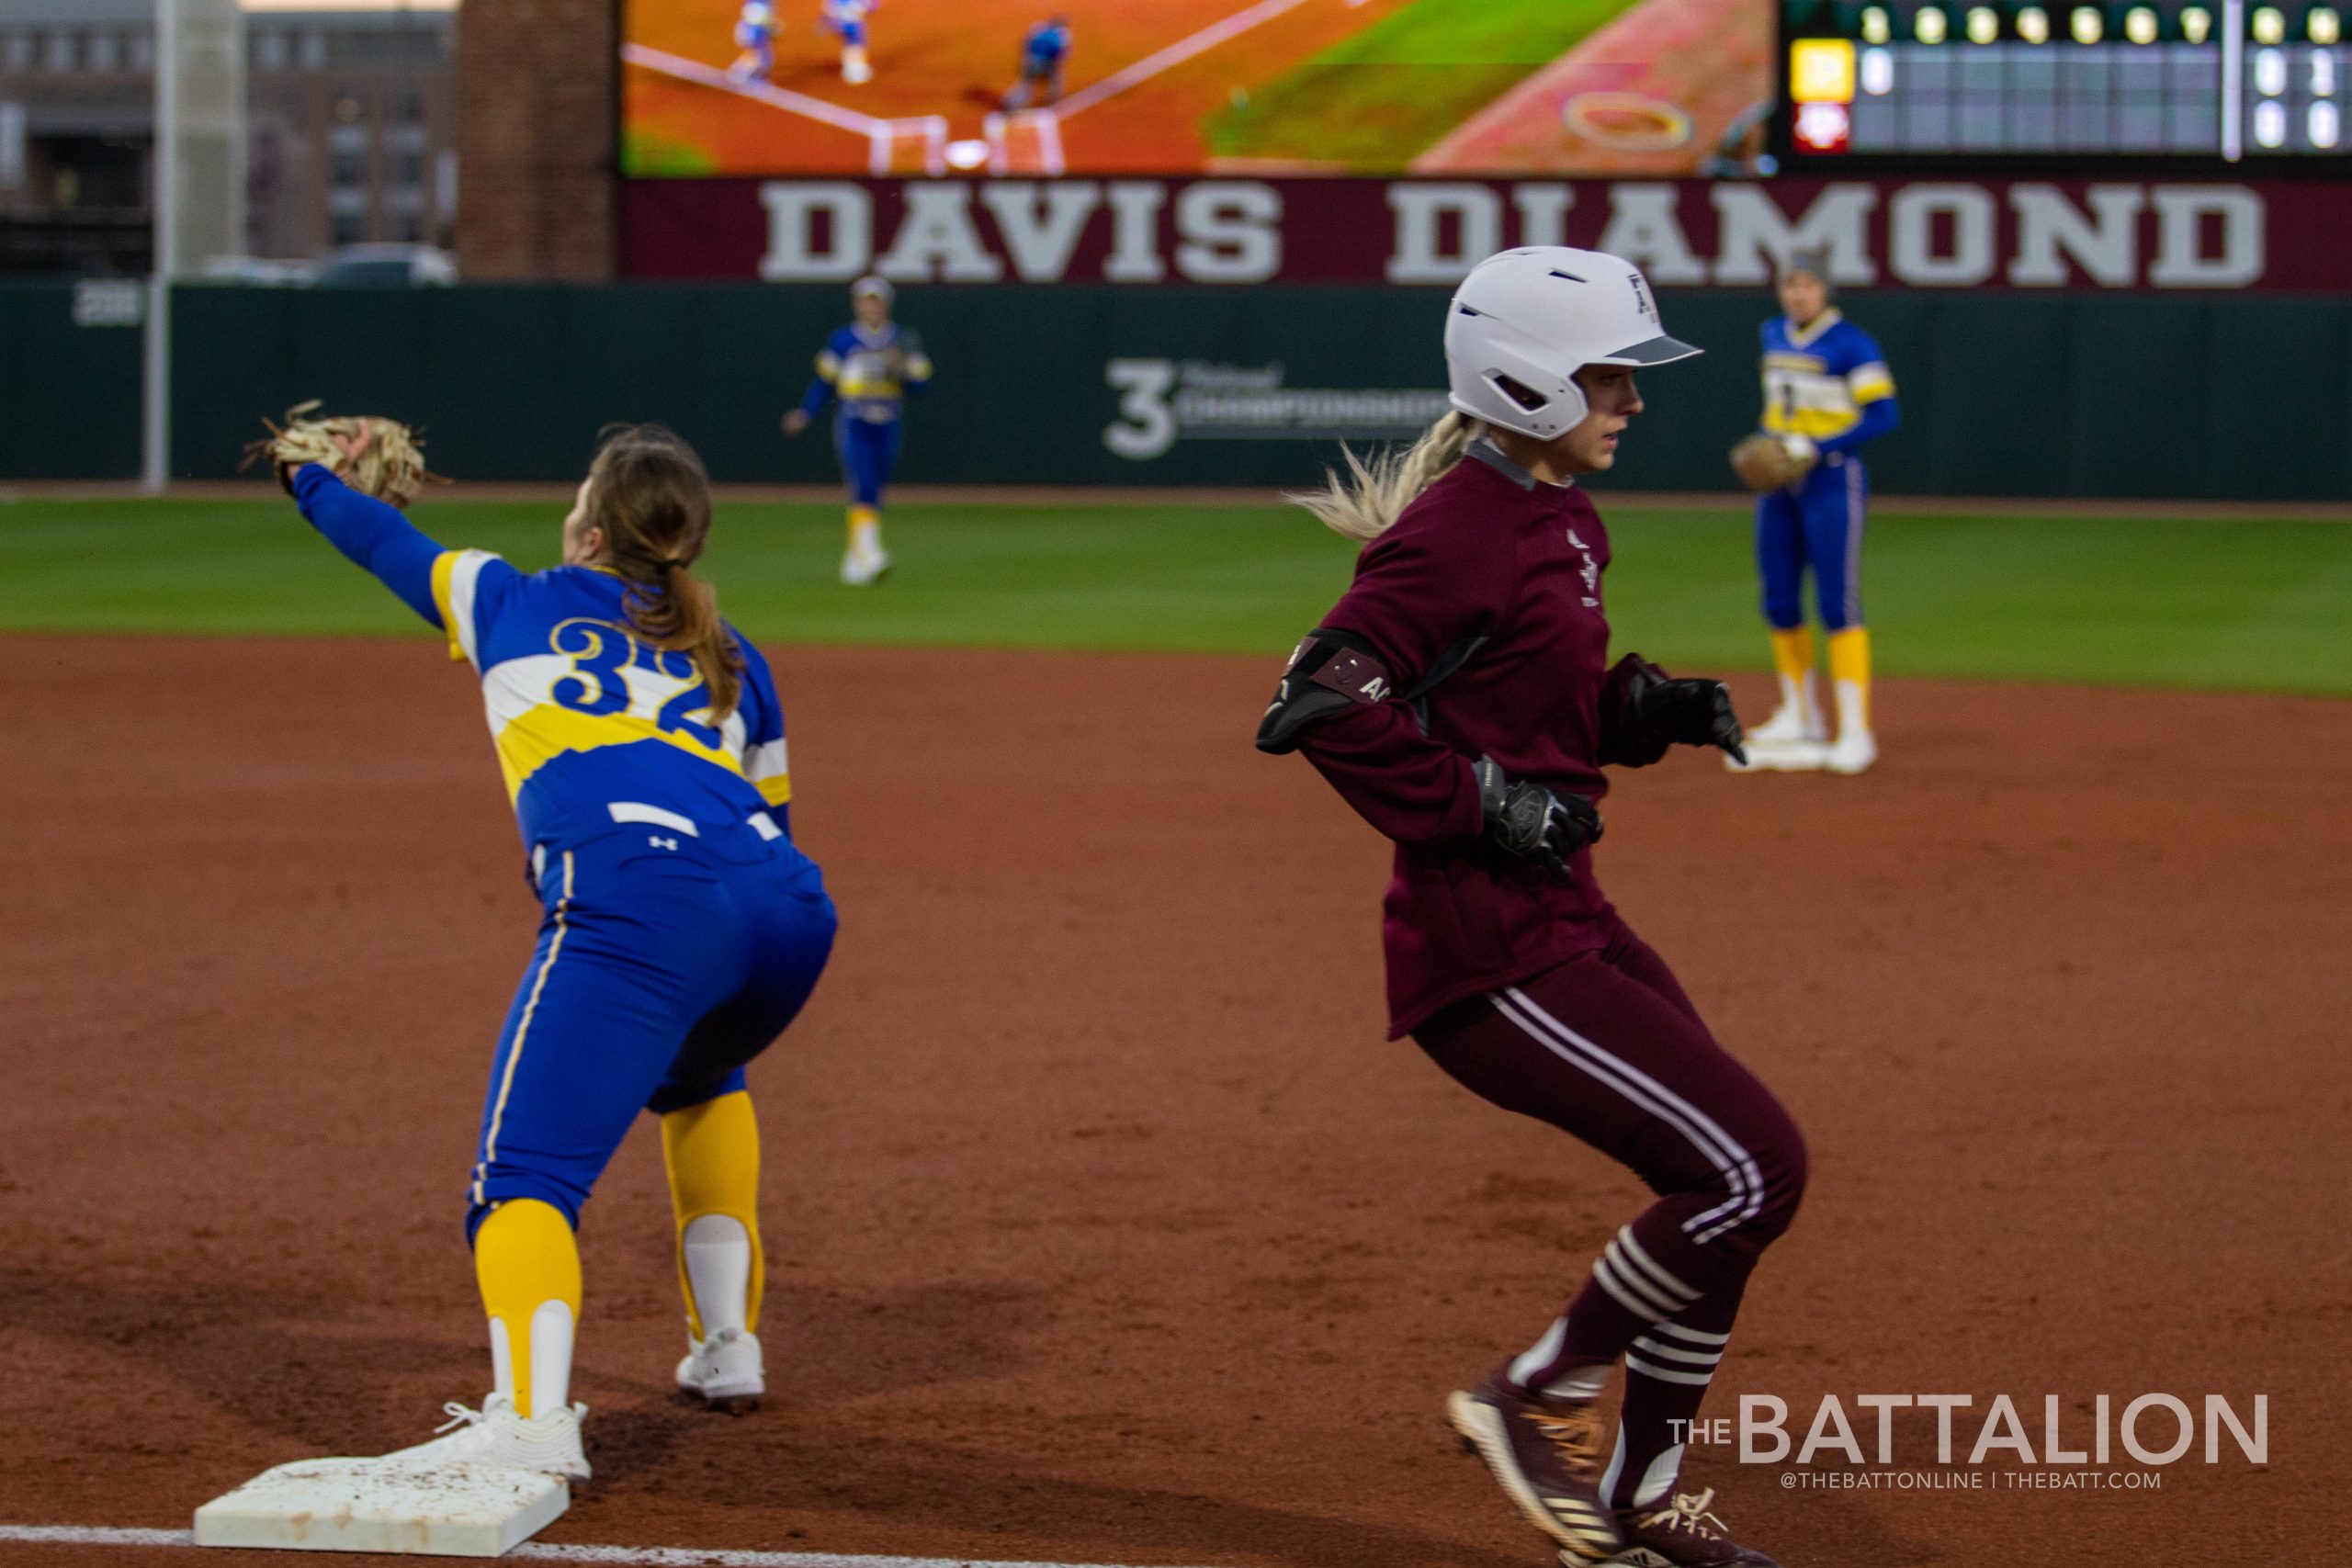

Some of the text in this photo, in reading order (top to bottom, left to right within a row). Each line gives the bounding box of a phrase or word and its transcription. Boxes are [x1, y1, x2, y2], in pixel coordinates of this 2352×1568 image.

[759, 182, 2266, 287] DAVIS DIAMOND
[1104, 358, 1176, 459] 3
[549, 616, 728, 752] 32
